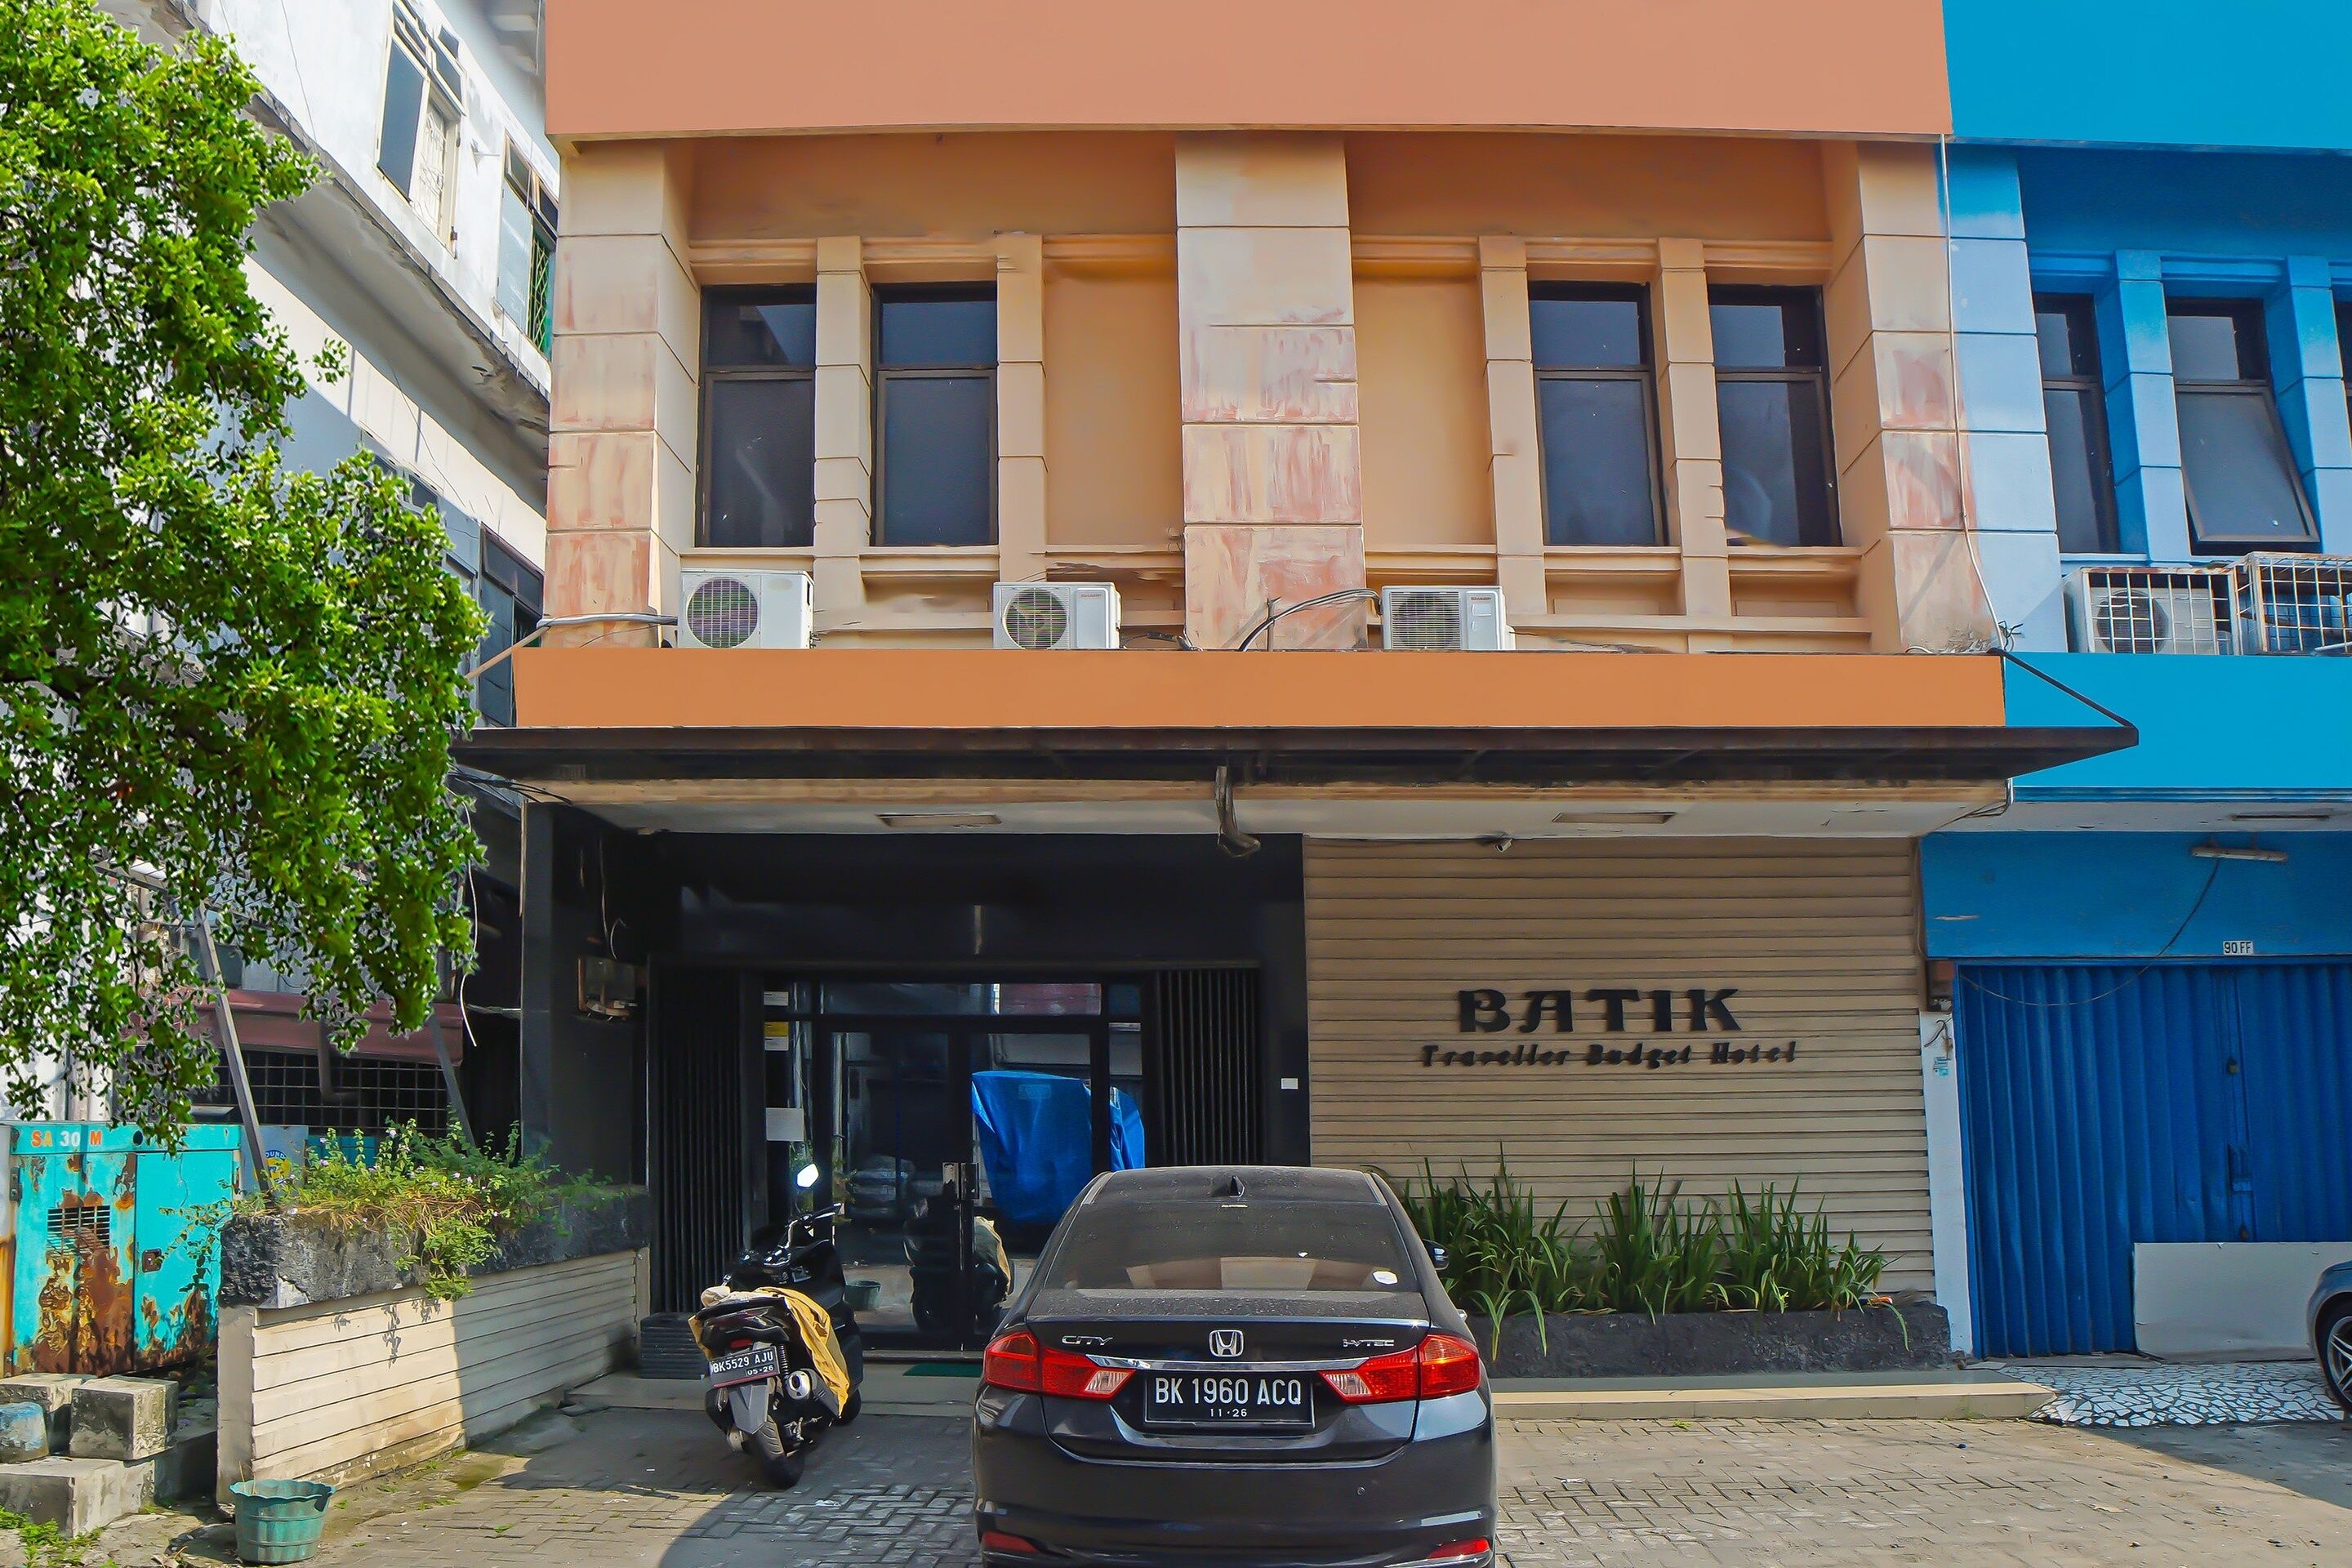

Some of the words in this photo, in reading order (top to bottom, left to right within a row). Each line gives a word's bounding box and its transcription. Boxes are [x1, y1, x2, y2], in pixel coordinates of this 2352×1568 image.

[1458, 988, 1742, 1033] BATIK
[1422, 1044, 1571, 1067] Traveller
[1585, 1043, 1691, 1070] Budget
[1710, 1040, 1797, 1064] Hotel
[31, 1130, 53, 1147] SA
[60, 1130, 81, 1147] 30
[90, 1130, 102, 1146] M
[1062, 1335, 1114, 1346] CITY
[755, 1351, 773, 1365] AJU
[1155, 1377, 1184, 1404] BK
[1192, 1378, 1249, 1405] 1960
[1257, 1379, 1301, 1405] ACQ
